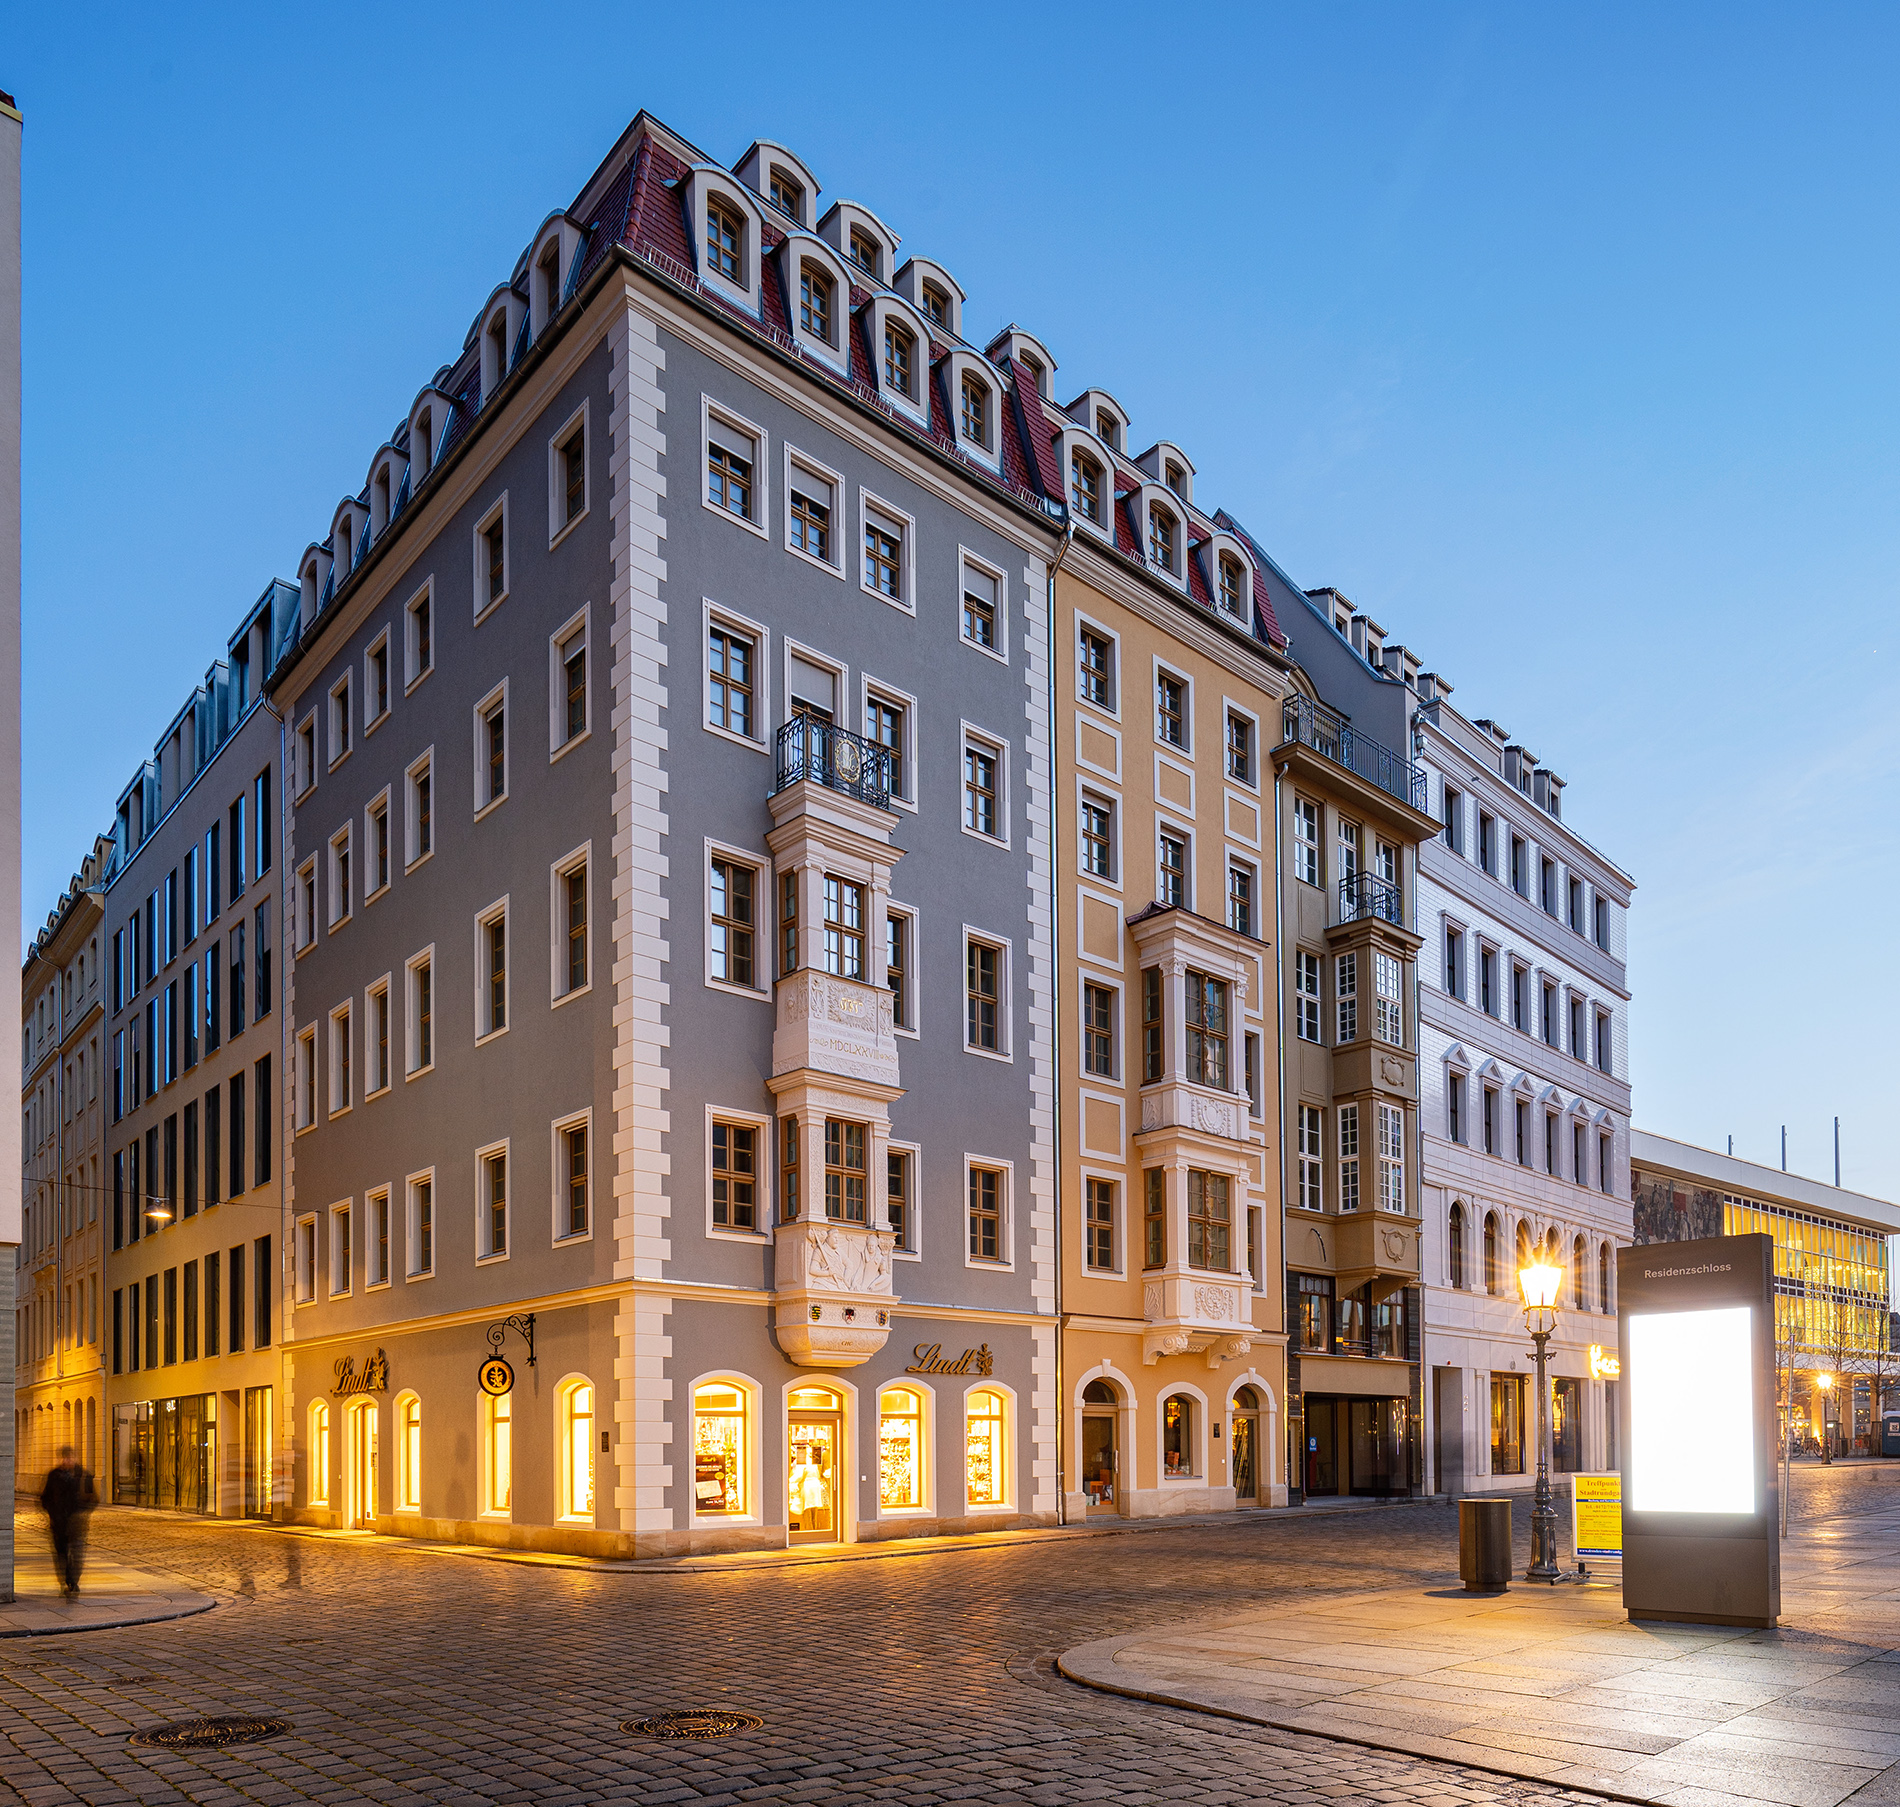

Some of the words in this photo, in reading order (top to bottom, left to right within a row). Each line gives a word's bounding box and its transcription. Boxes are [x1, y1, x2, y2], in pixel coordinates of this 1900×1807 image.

[1644, 1263, 1732, 1279] Residenzschloss
[330, 1355, 374, 1394] Lindt
[905, 1342, 978, 1375] Lindt
